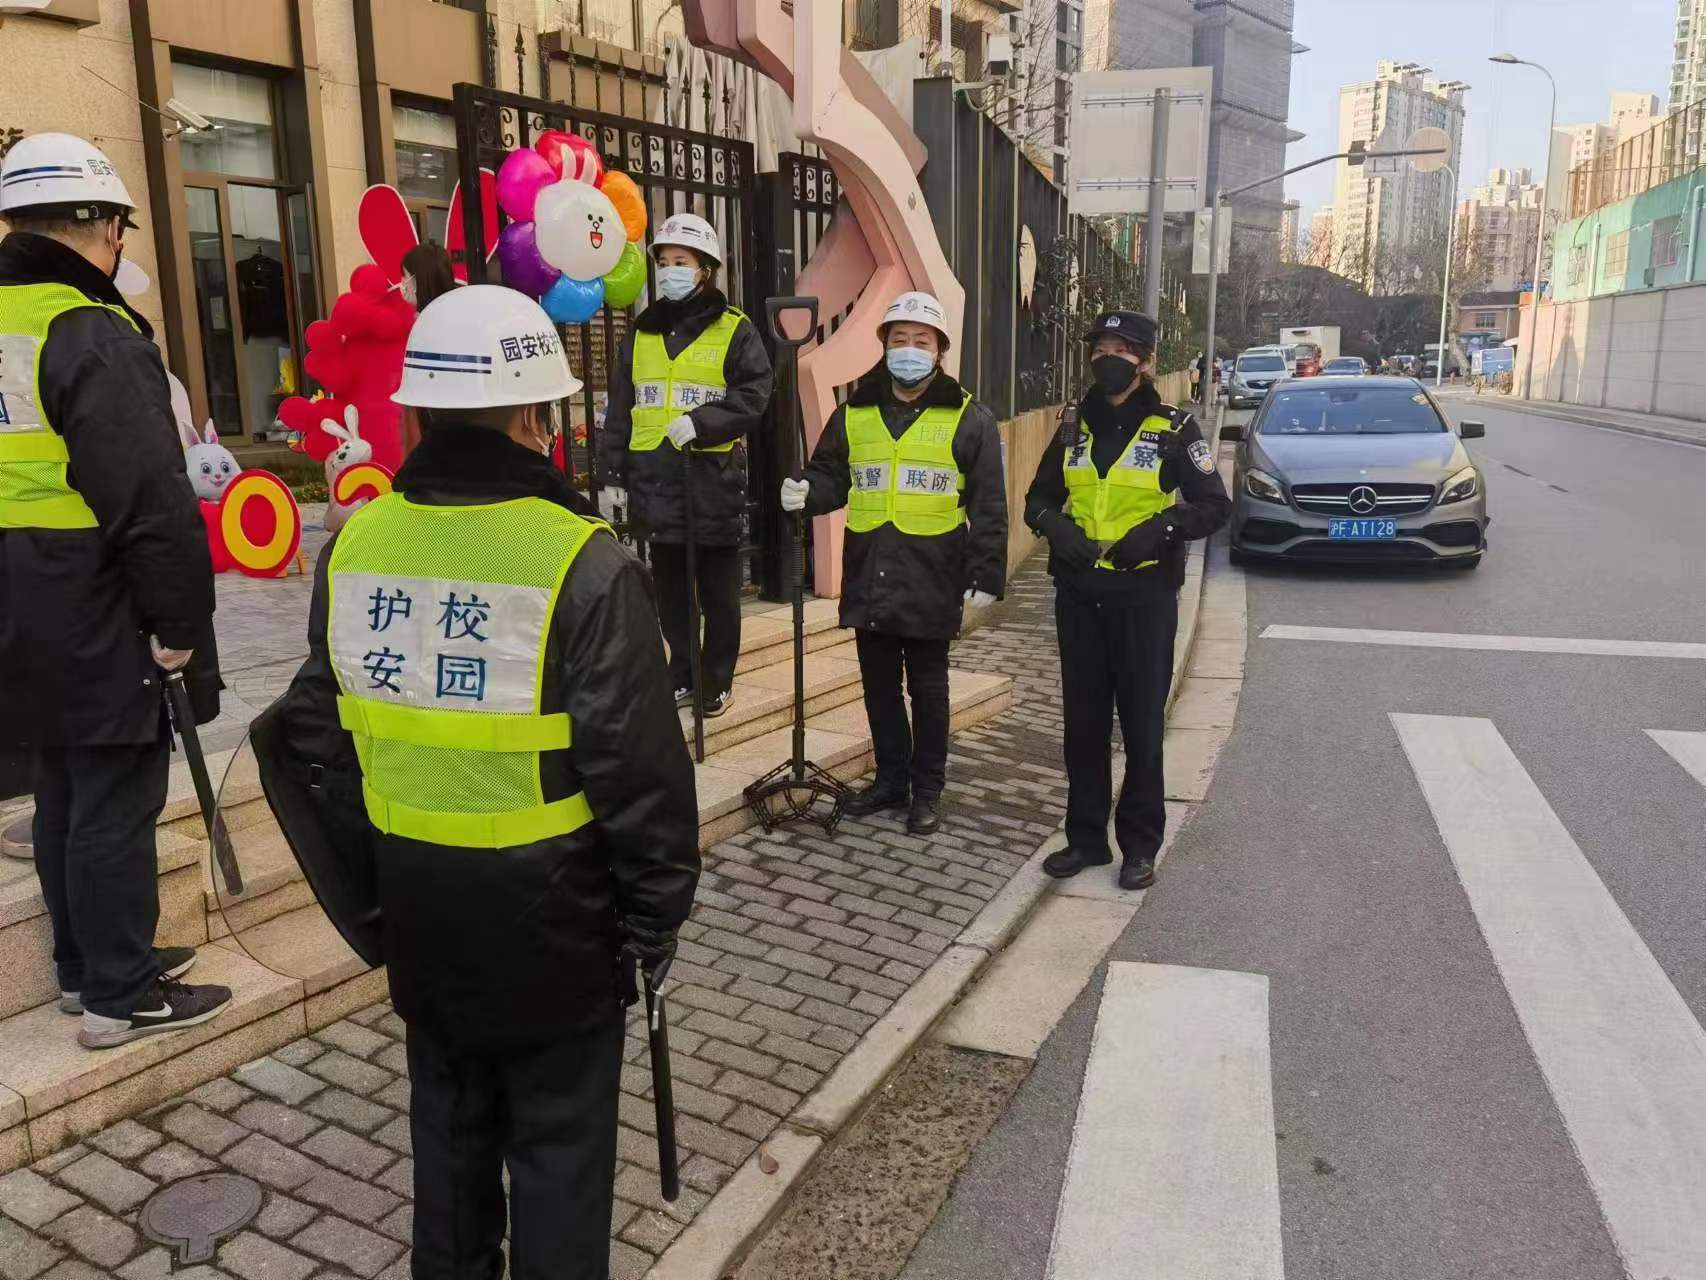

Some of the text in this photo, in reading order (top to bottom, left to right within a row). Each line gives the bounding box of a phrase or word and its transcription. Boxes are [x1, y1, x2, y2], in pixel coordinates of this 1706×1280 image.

[1133, 445, 1157, 469] 察
[367, 587, 491, 642] 护校
[363, 647, 487, 701] 安园
